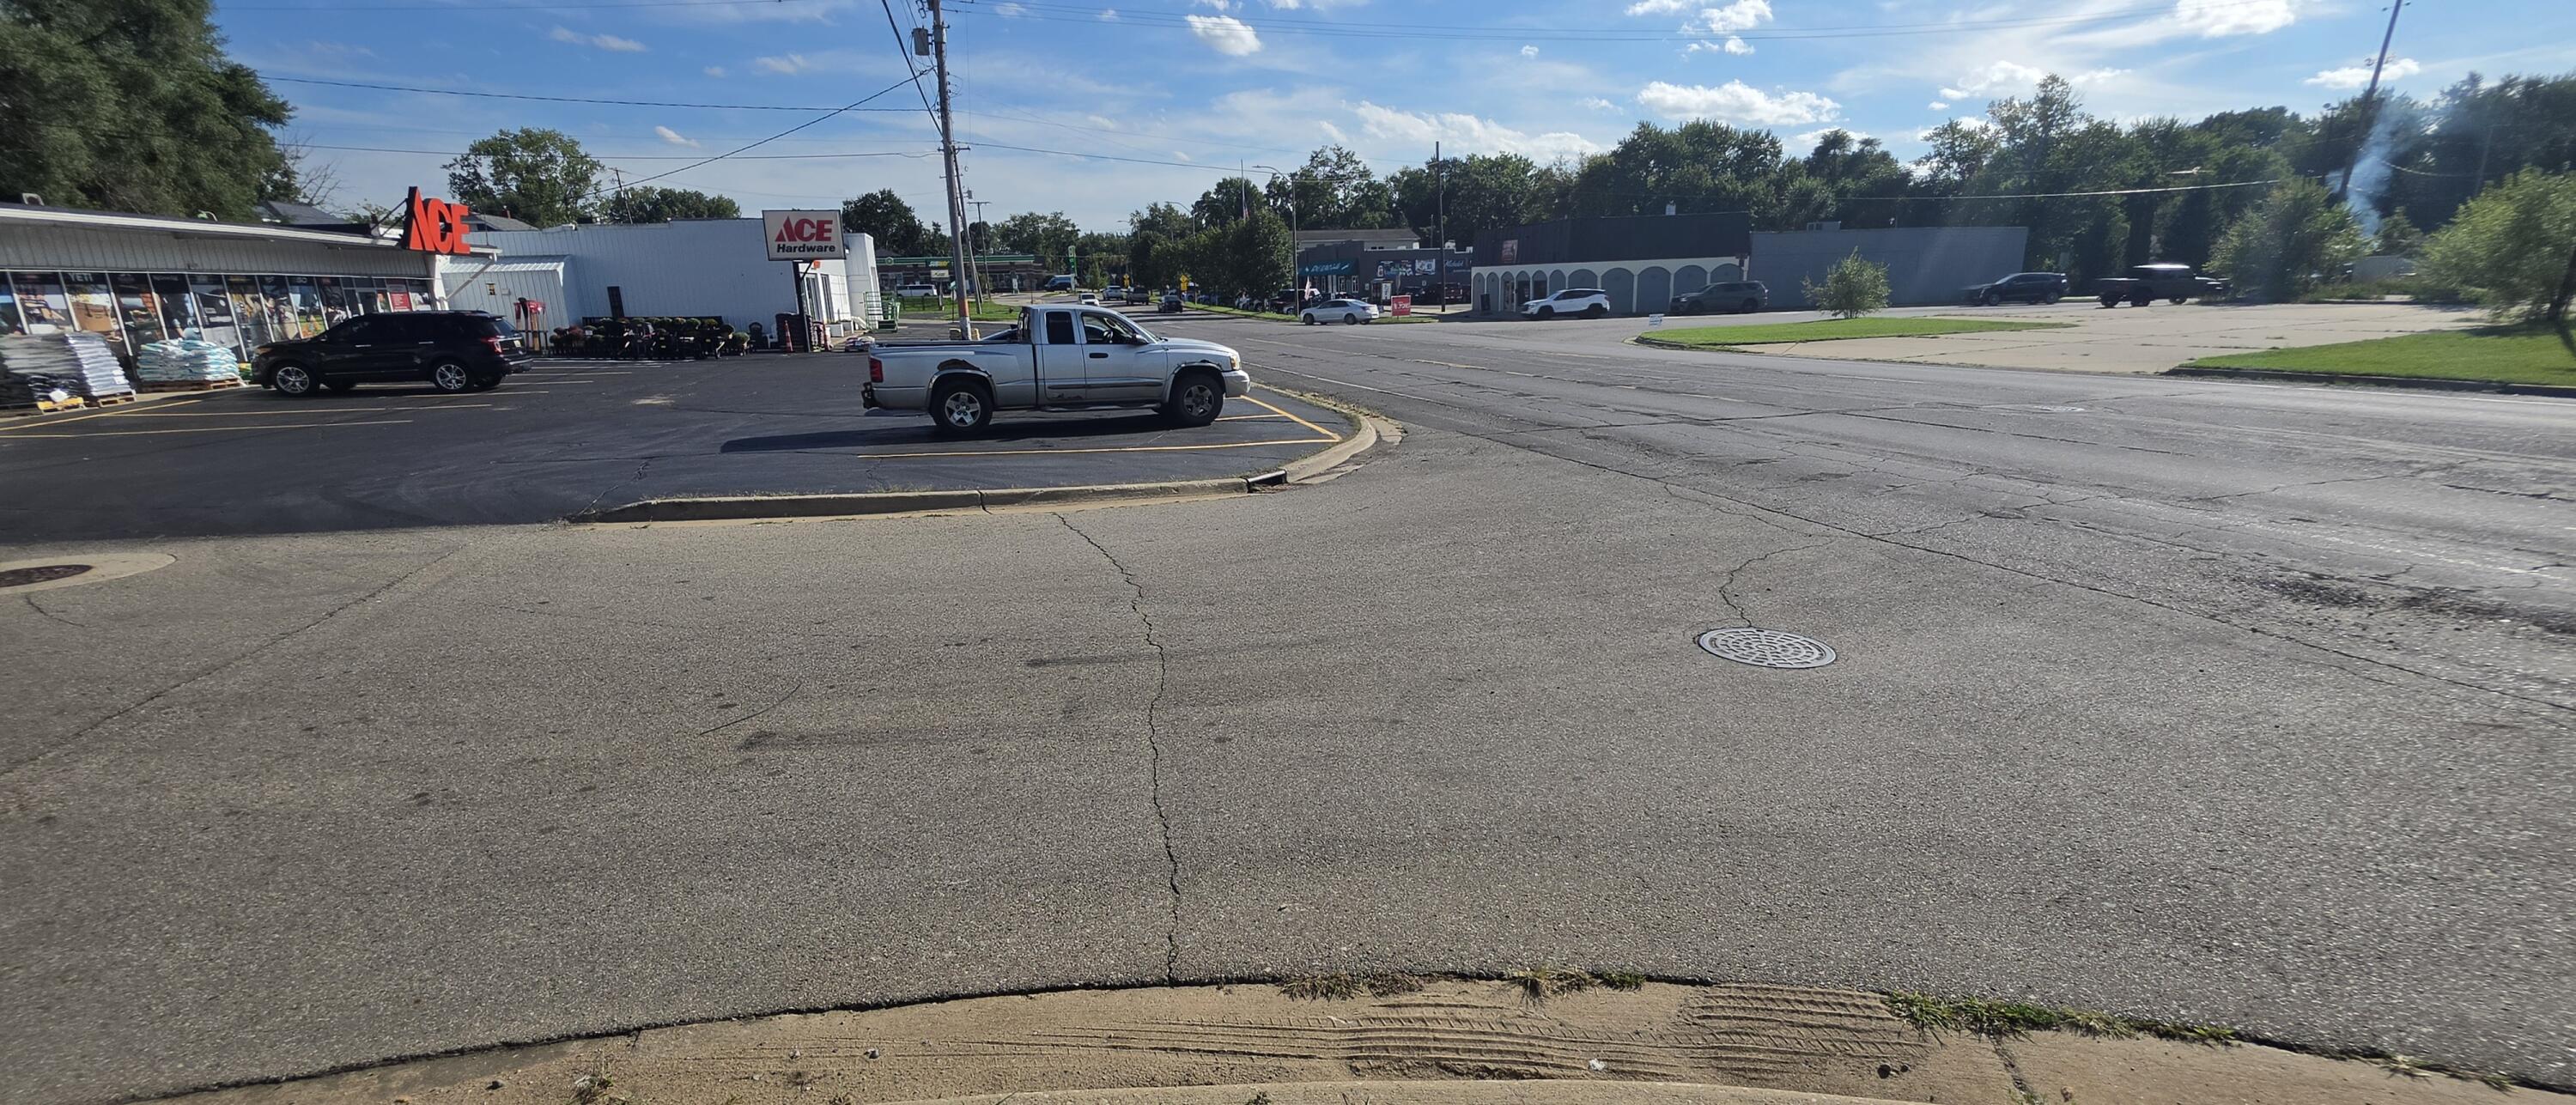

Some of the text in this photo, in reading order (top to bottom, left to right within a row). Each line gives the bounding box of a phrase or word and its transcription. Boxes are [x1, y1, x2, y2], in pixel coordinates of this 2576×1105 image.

[410, 187, 471, 254] ACE
[775, 216, 833, 242] ACE
[776, 244, 835, 252] Hardware
[68, 272, 94, 282] YETI
